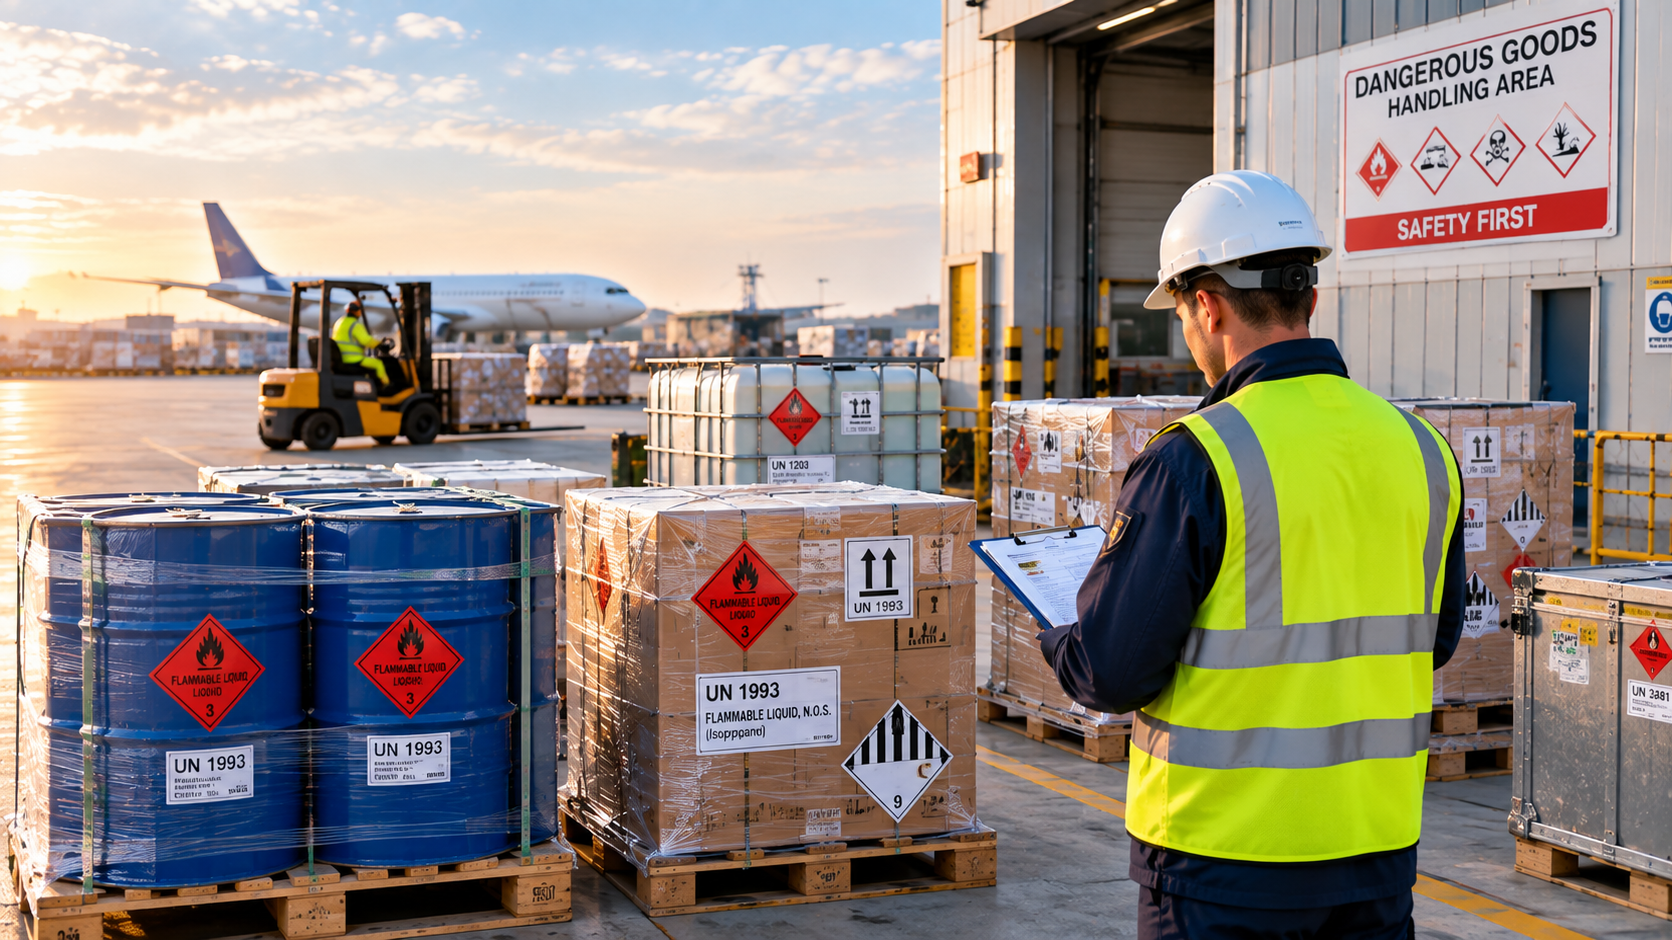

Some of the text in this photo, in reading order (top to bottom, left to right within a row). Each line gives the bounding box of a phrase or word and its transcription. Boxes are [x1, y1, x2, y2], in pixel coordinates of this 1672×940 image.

[1355, 20, 1597, 98] DANGEROUS GOODS
[1388, 64, 1555, 118] HANDLING AREA
[1397, 205, 1537, 241] SAFETY FIRST
[772, 461, 809, 470] UN 1203
[709, 597, 755, 609] FLAMMABLE
[854, 600, 903, 614] UN 1993
[741, 625, 749, 638] 3
[374, 664, 422, 674] FLAMMABLE
[171, 674, 221, 685] FLAMMABLE
[406, 692, 414, 705] 3
[706, 682, 780, 702] UN 1993
[1632, 685, 1646, 698] UN
[206, 703, 214, 717] 3
[705, 704, 831, 724] FLAMMABLE LIQUID, N.O.S.
[374, 740, 442, 757] UN 1993
[174, 754, 245, 773] UN 1993
[894, 795, 902, 809] 9
